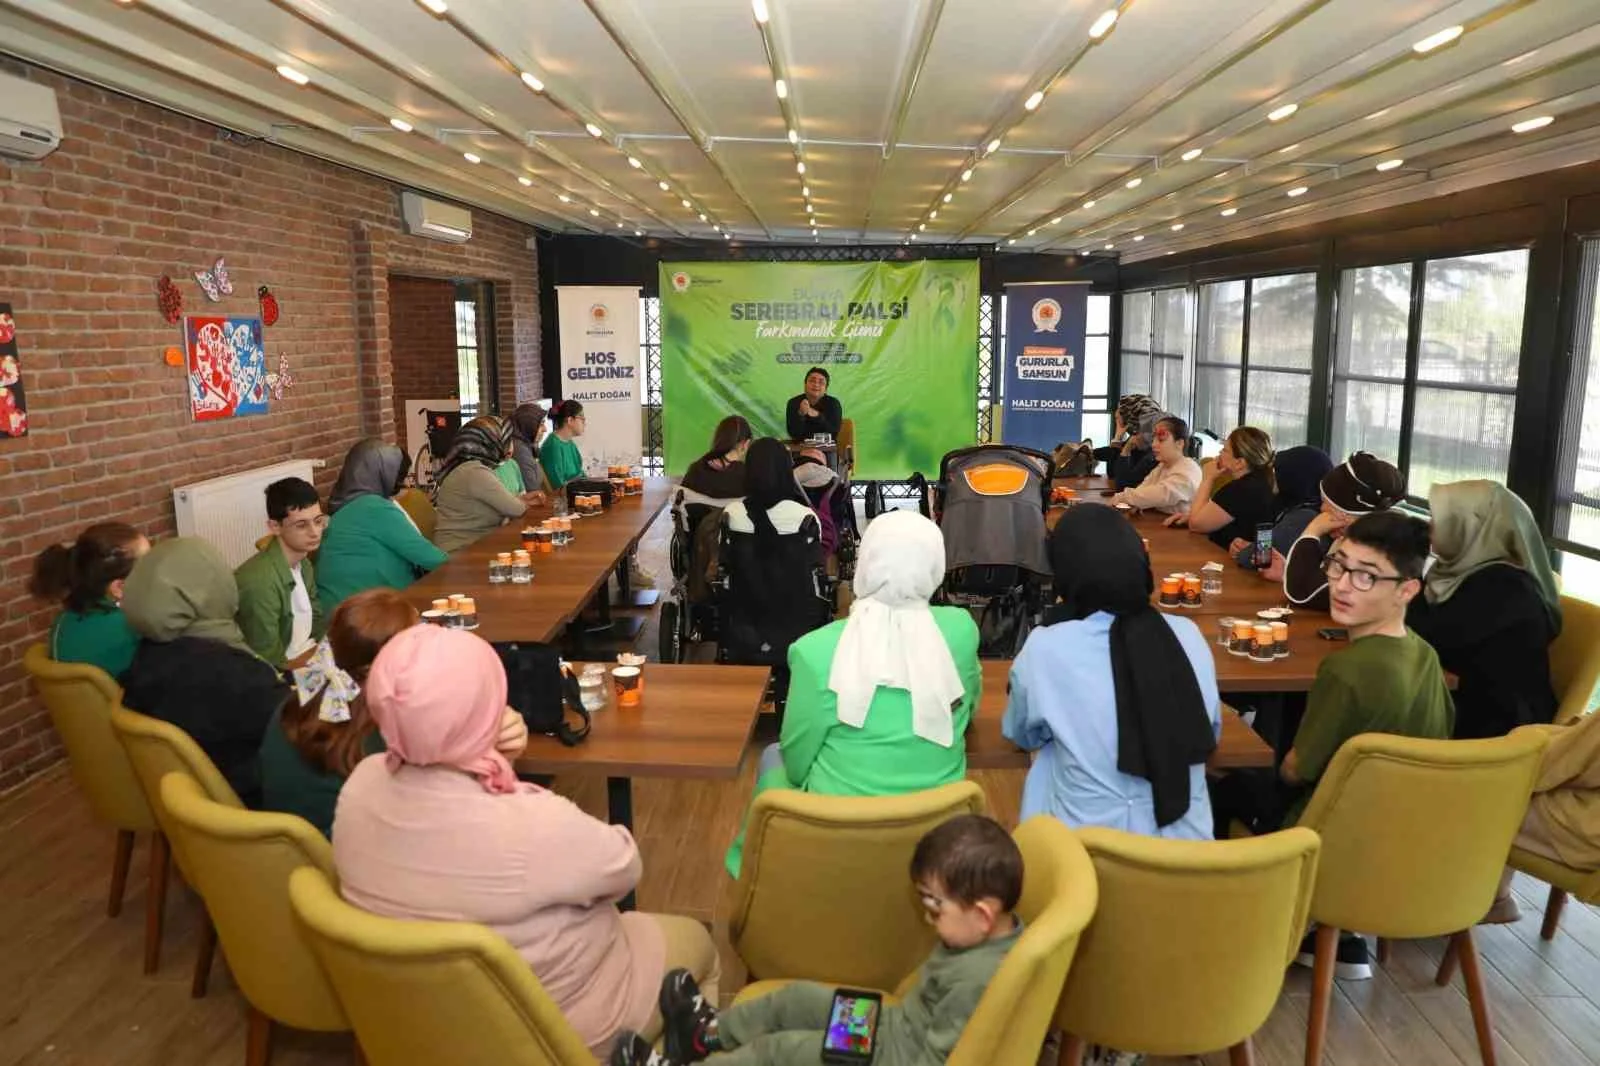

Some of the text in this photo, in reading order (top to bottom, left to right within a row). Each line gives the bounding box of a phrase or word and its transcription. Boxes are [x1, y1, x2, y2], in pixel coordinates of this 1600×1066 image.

[730, 296, 909, 321] SEREBRAL PALSİ
[585, 351, 616, 366] HOŞ
[1019, 357, 1070, 367] GURURLA
[1022, 369, 1067, 378] SAMSUN
